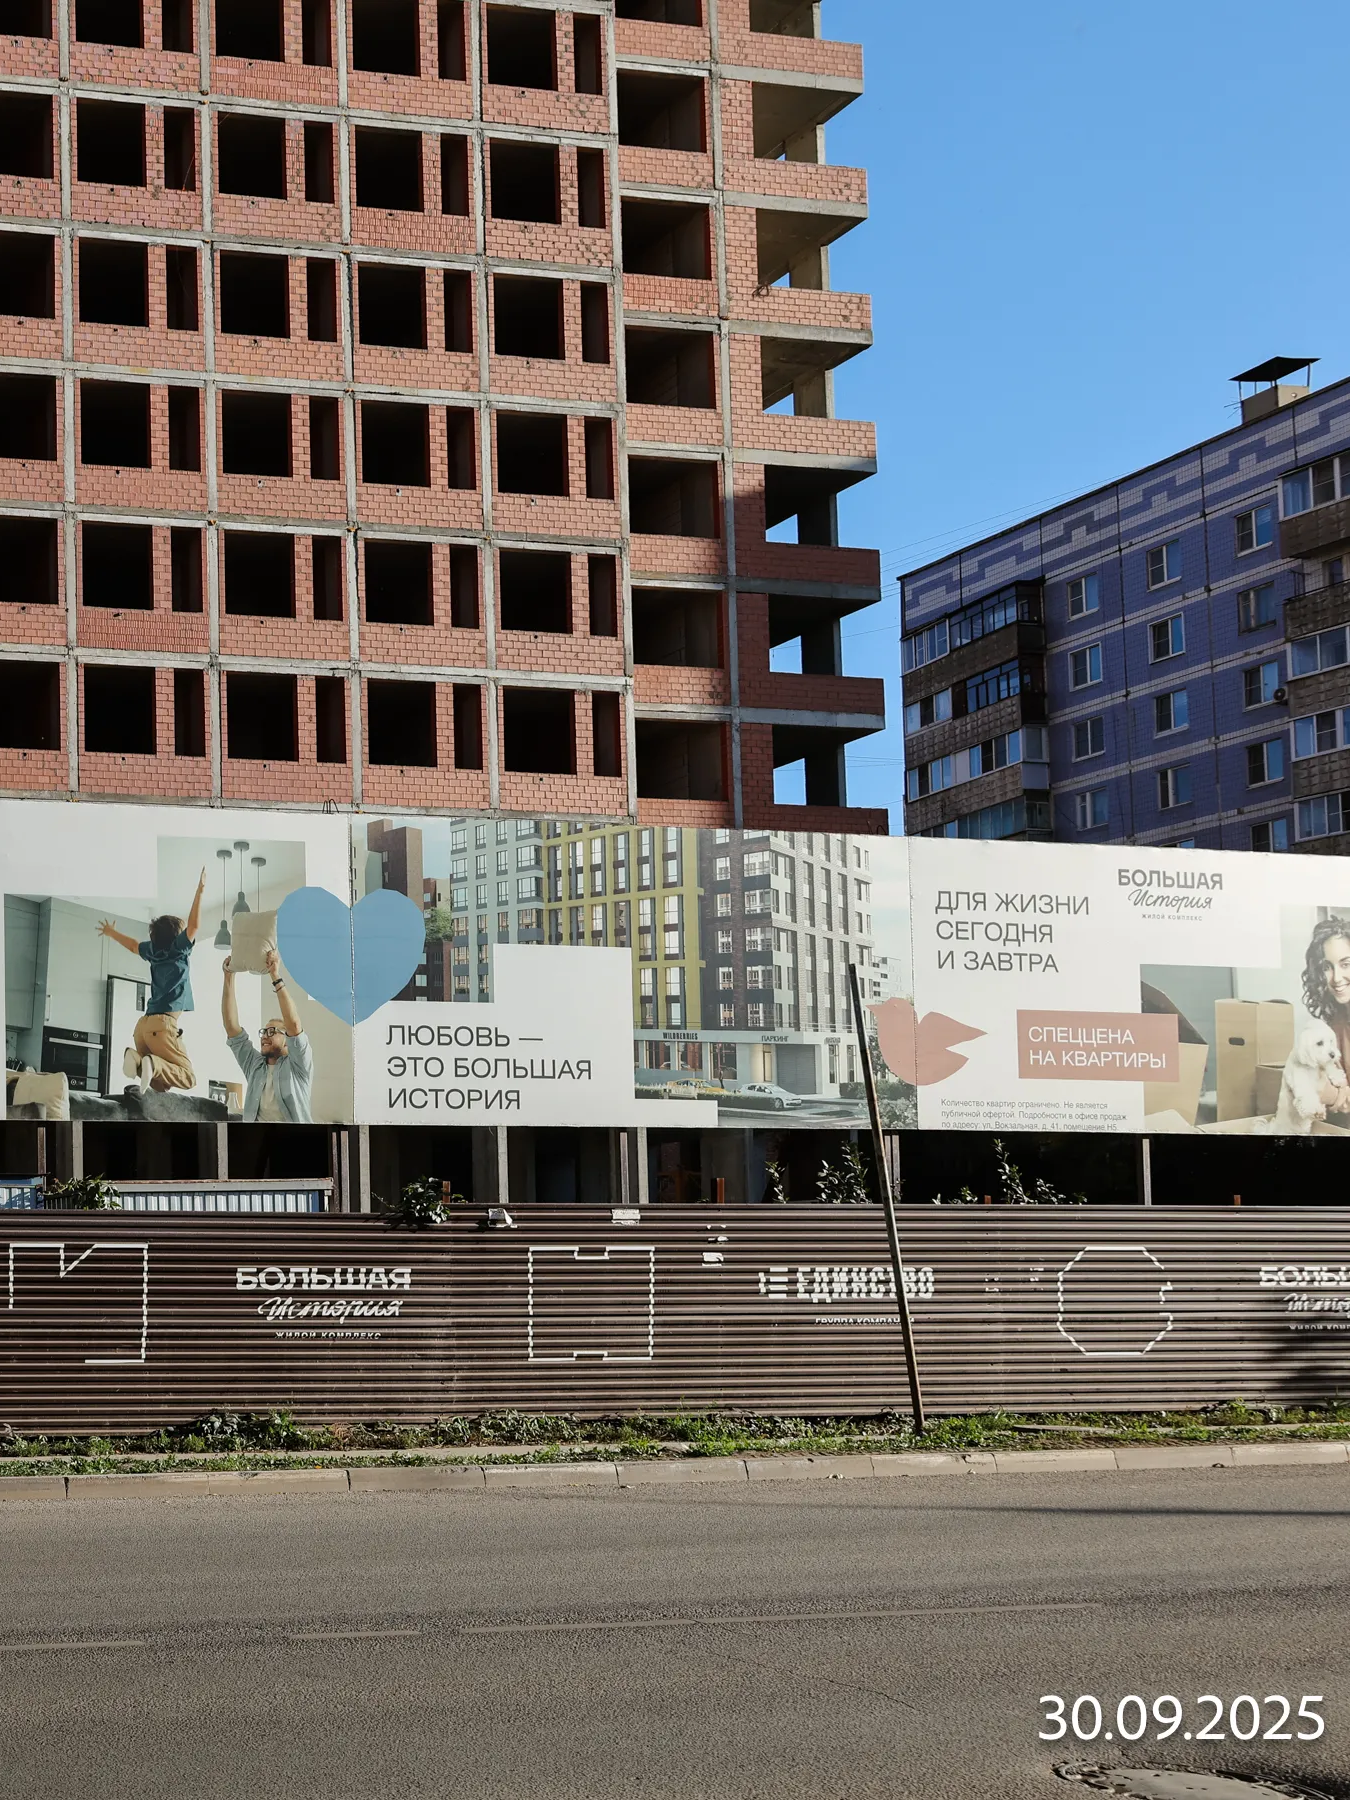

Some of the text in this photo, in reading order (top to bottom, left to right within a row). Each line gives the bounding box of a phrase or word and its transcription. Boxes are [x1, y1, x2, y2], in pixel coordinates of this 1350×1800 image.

[1118, 868, 1223, 890] БОЛЬШАЯ
[935, 891, 1089, 915] ДЛЯ ЖИЗНИ
[1128, 888, 1213, 913] История
[936, 920, 1053, 947] СЕГОДНЯ
[938, 950, 1059, 973] И ЗАВТРА
[386, 1025, 510, 1047] ЛЮБОВЬ
[662, 1032, 698, 1040] WILDBERRIES
[1028, 1026, 1135, 1047] СПЕЦЦЕНА
[387, 1056, 591, 1080] ЭТО БОЛЬШАЯ
[1029, 1050, 1166, 1068] НА КВАРТИРЫ
[388, 1088, 521, 1110] ИСТОРИЯ
[941, 1099, 984, 1107] Количество
[986, 1101, 1016, 1109] квартир
[1018, 1101, 1061, 1109] ограничено.
[941, 1110, 980, 1119] публичной
[1018, 1111, 1067, 1120] Подробности
[1074, 1112, 1098, 1120] офисе
[1100, 1113, 1127, 1121] продаж
[1063, 1123, 1105, 1131] помещение
[236, 1266, 412, 1290] БОЛЬШАЯ
[257, 1296, 404, 1324] История
[320, 1331, 382, 1340] КОМПЛЕКС
